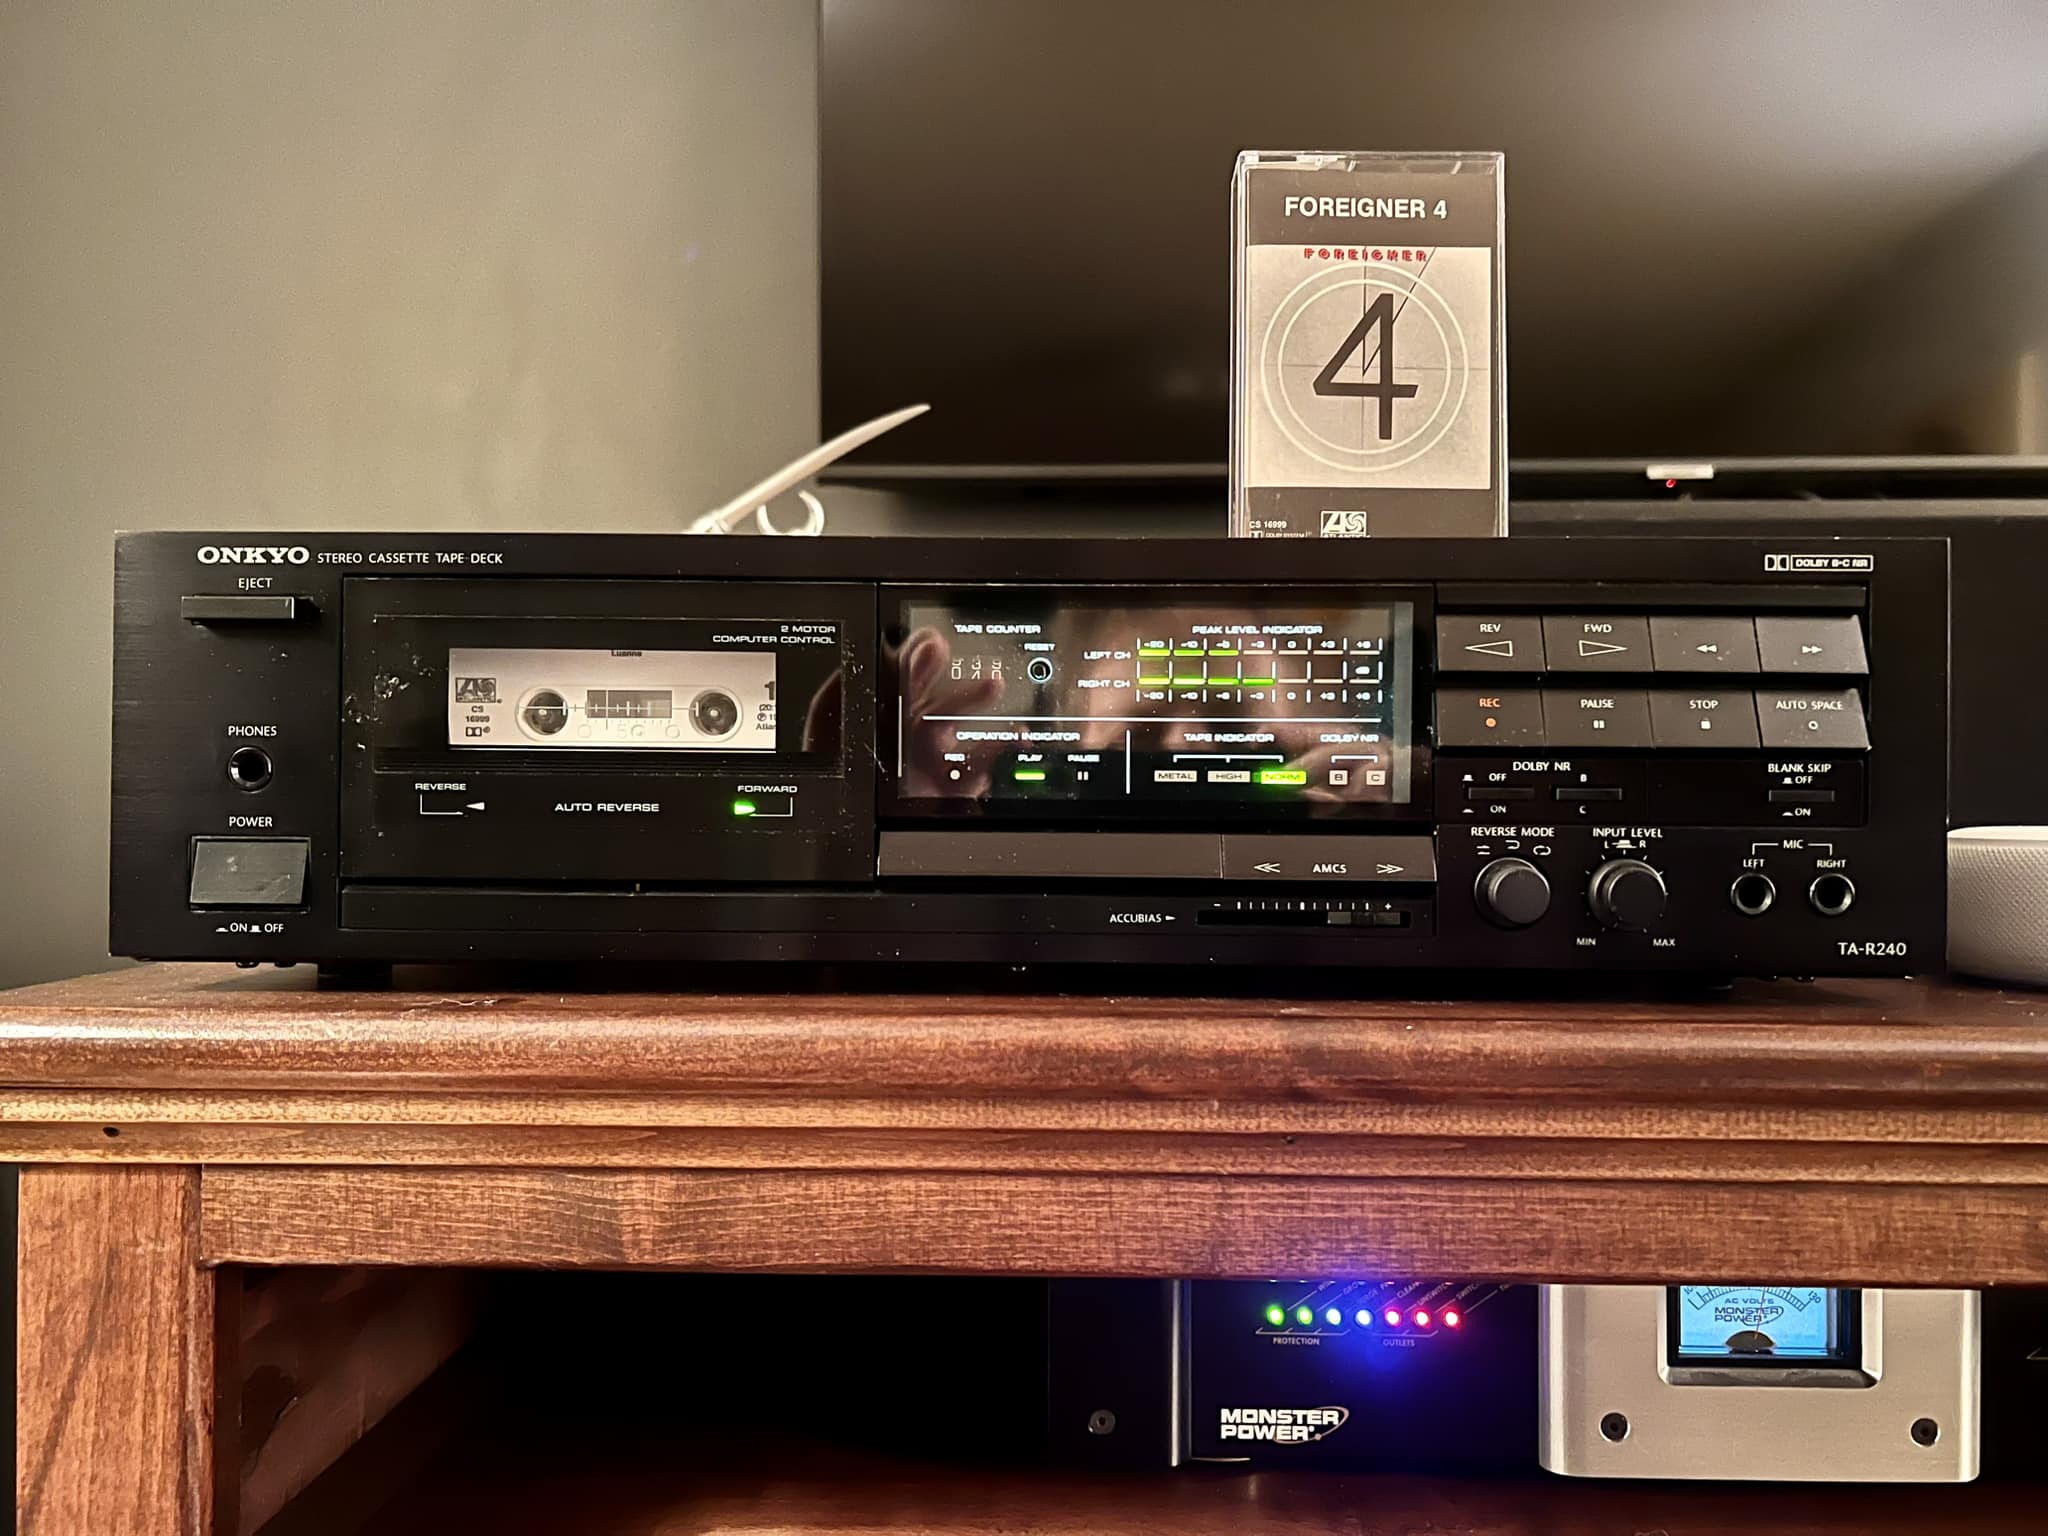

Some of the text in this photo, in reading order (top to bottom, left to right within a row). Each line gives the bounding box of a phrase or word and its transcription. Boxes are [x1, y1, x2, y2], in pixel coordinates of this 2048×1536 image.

[1284, 196, 1447, 219] FOREIGNER 4
[1303, 248, 1428, 262] FOREIGNER
[1313, 293, 1418, 440] 4
[197, 546, 503, 565] ONKYO STEREO CASSETTE TAPE DECK
[1795, 559, 1830, 567] DOLBY
[1852, 559, 1868, 567] NR
[238, 577, 272, 591] EJECT
[780, 625, 836, 633] 2 MOTOR
[954, 624, 1041, 634] TAPE COUNTER
[1192, 625, 1323, 634] PEAK LEVEL INDICATOR
[1480, 623, 1501, 633] REV
[1584, 623, 1612, 633] FWD
[712, 635, 836, 644] COMPUTER CONTROL
[1024, 643, 1055, 651] RESET
[1084, 651, 1131, 660] LEFT CH
[1077, 680, 1130, 688] RIGHT CH
[764, 681, 775, 700] 1
[1479, 698, 1501, 708] REC
[1580, 699, 1615, 709] PAUSE
[1689, 700, 1719, 710] STOP
[1776, 700, 1844, 710] AUTO SPACE
[228, 725, 278, 737] PHONES
[956, 732, 1080, 741] OPERATION INDICATOR
[1183, 733, 1275, 742] TAPE INDICATOR
[1320, 733, 1379, 743] DOLBY NR
[1018, 754, 1042, 762] PLAY
[1067, 754, 1100, 762] PAUSE
[1512, 761, 1571, 771] DOLBY NR
[1768, 763, 1831, 773] BLANK SKIP
[1158, 772, 1194, 780] METAL
[1215, 772, 1242, 780] HIGH
[1264, 773, 1301, 781] NORM
[1334, 773, 1343, 781] B
[1371, 773, 1381, 781] C
[1488, 773, 1507, 782] OFF
[1580, 774, 1587, 782] B
[1795, 776, 1813, 784] OFF
[415, 783, 467, 791] REVERSE
[737, 785, 798, 793] FORWARD
[554, 803, 660, 812] AUTO REVERSE
[1490, 805, 1507, 814] ON
[1579, 806, 1587, 814] C
[1794, 808, 1811, 816] ON
[229, 816, 272, 828] POWER
[1471, 827, 1555, 837] REVERSE MODE
[1593, 828, 1663, 838] INPUT LEVEL
[1639, 840, 1646, 848] R
[1783, 840, 1804, 849] MIC
[1743, 859, 1765, 867] LEFT
[1817, 859, 1847, 868] RIGHT
[1313, 864, 1347, 873] AMCS
[1109, 913, 1162, 923] ACCUBIAS
[230, 922, 248, 933] ON
[264, 922, 284, 933] OFF
[1576, 938, 1596, 946] MIN
[1653, 938, 1675, 947] MAX
[1838, 942, 1907, 956] TA-R240
[1808, 1290, 1822, 1304] 130
[1714, 1307, 1779, 1315] MONSTER
[1714, 1314, 1762, 1323] POWER
[1273, 1336, 1320, 1346] PROTECTION
[1383, 1338, 1415, 1347] OUTLETS
[1220, 1408, 1339, 1425] MONSTER
[1220, 1425, 1310, 1440] POWER
